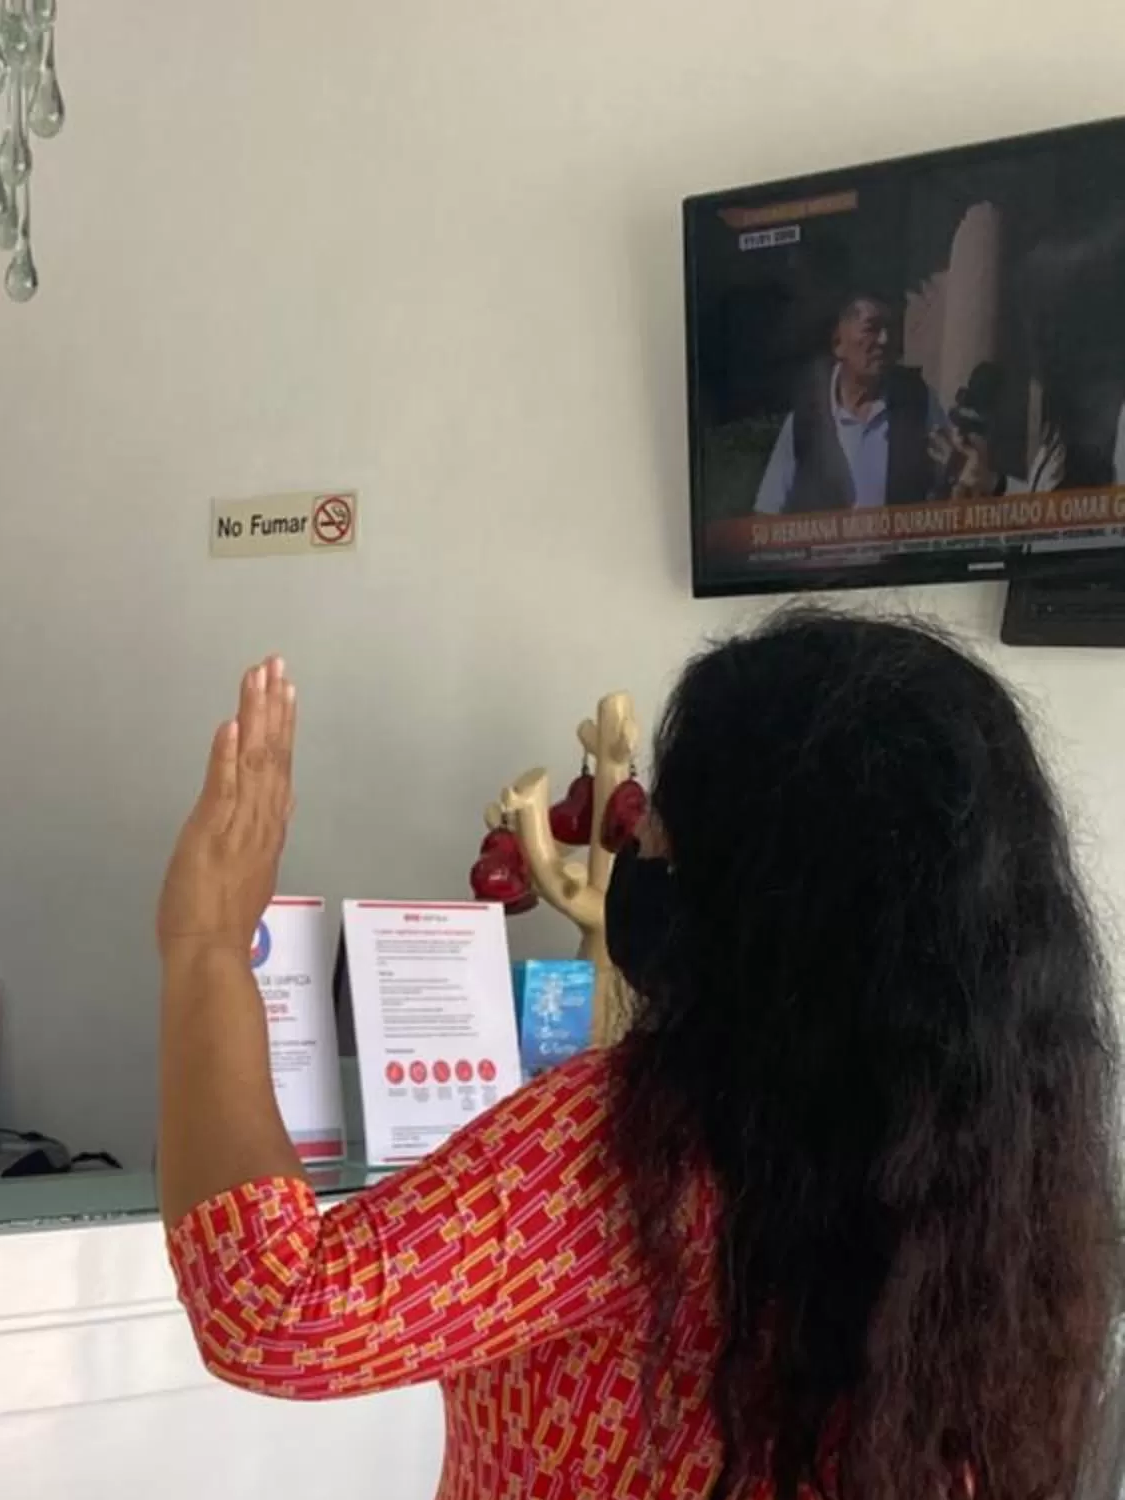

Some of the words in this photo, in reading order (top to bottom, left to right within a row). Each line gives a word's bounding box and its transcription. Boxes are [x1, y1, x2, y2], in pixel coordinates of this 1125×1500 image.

[217, 516, 242, 538] No
[250, 513, 308, 536] Fumar
[894, 507, 960, 534] DURANTE
[965, 499, 1042, 529] ATENTADO
[1045, 499, 1057, 522] A
[1061, 495, 1110, 522] OMAR
